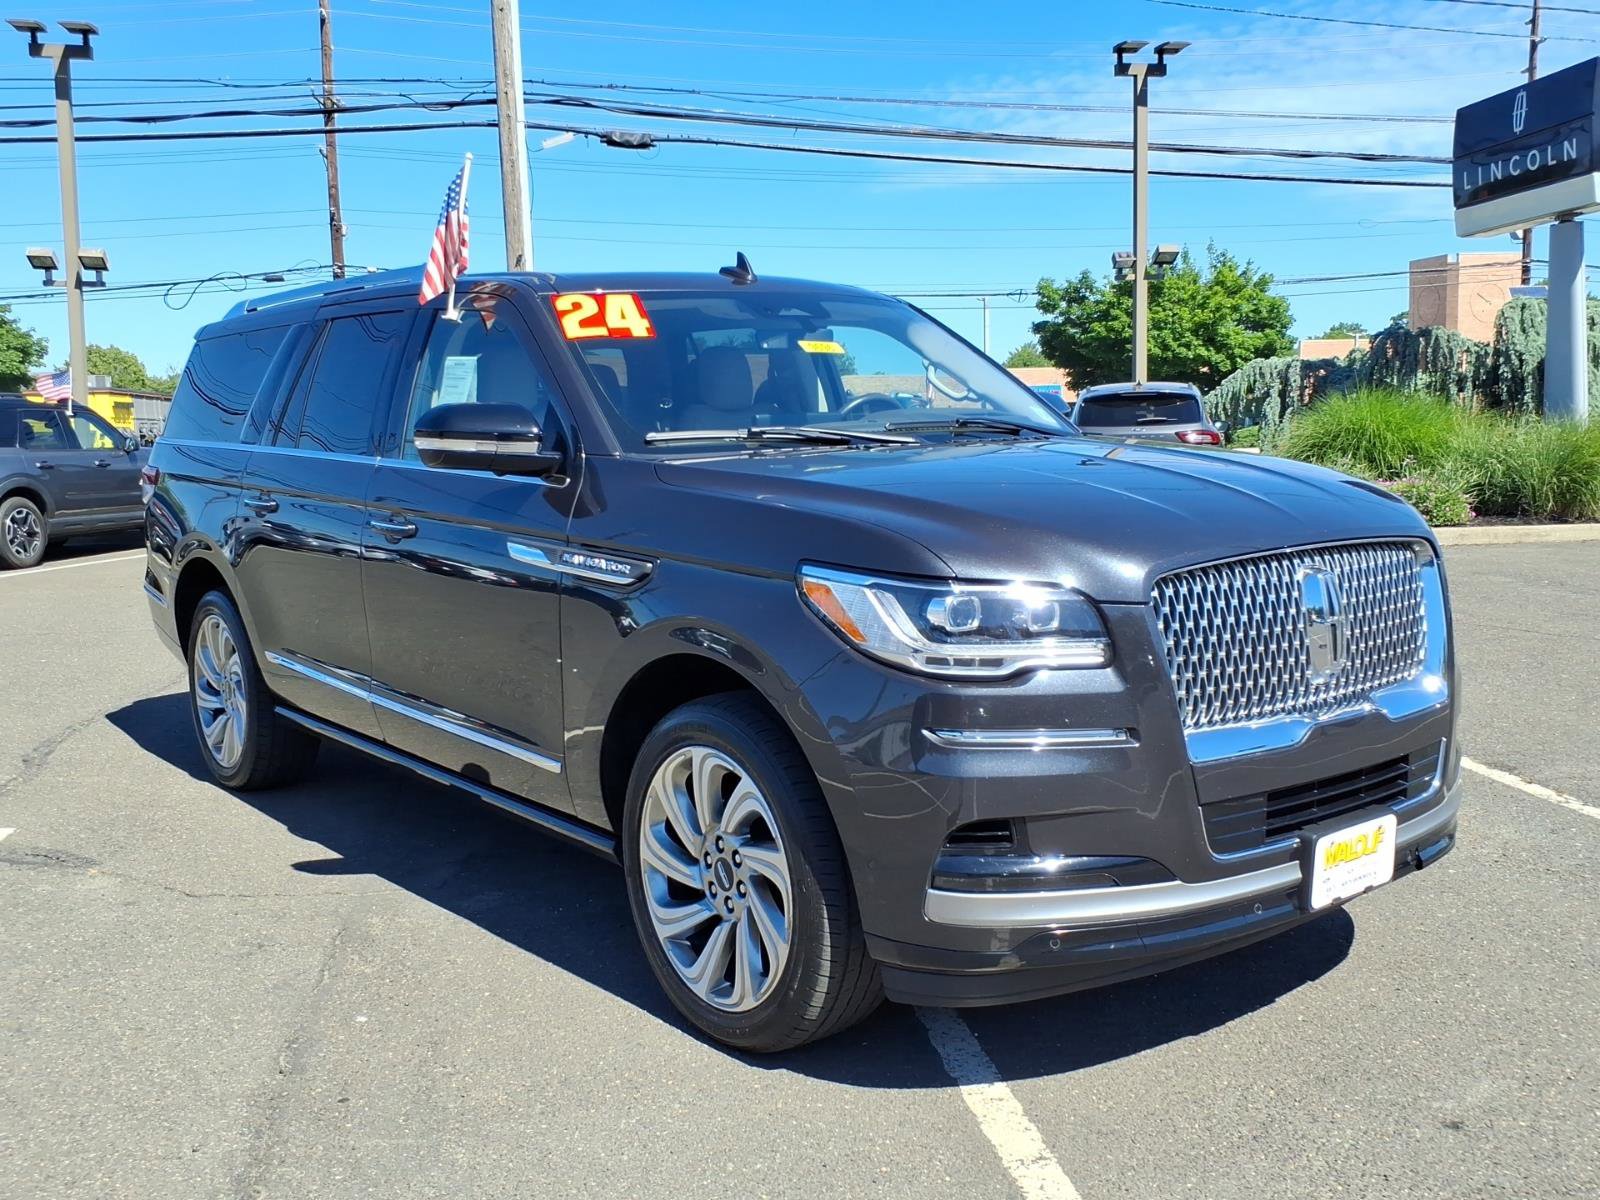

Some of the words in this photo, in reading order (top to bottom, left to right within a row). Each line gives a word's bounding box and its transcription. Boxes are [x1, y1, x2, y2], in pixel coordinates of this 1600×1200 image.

[1463, 138, 1577, 190] LINCOLN
[555, 294, 651, 339] 24
[563, 553, 631, 574] NAVIGATOR
